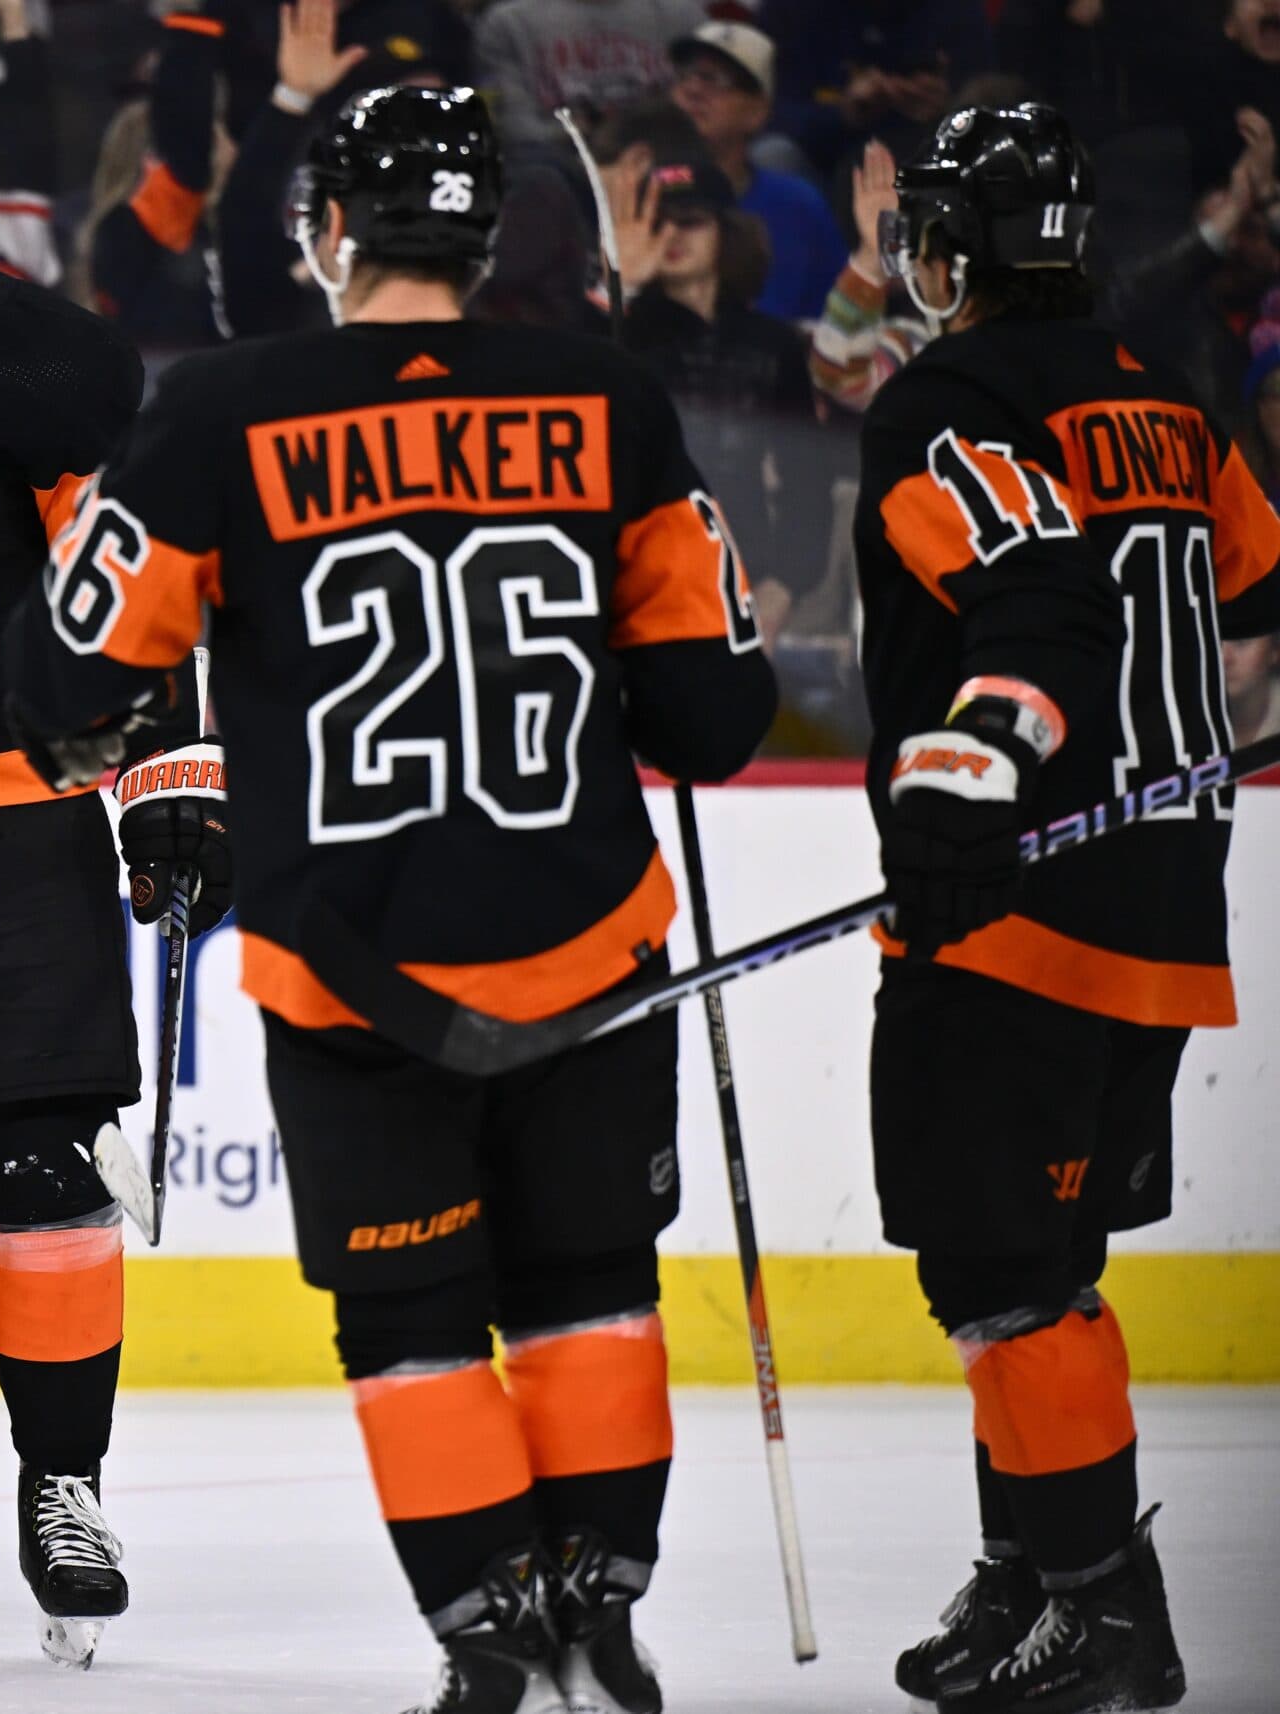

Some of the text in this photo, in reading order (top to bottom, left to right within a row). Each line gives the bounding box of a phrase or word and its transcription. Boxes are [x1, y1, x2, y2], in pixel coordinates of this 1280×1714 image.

[429, 169, 475, 213] 26
[1040, 202, 1066, 238] 11
[272, 408, 587, 525] WALKER
[927, 426, 1080, 567] 11
[301, 523, 600, 845] 26
[1109, 524, 1234, 821] 11
[121, 759, 229, 807] WARR
[347, 1199, 480, 1251] BAUER
